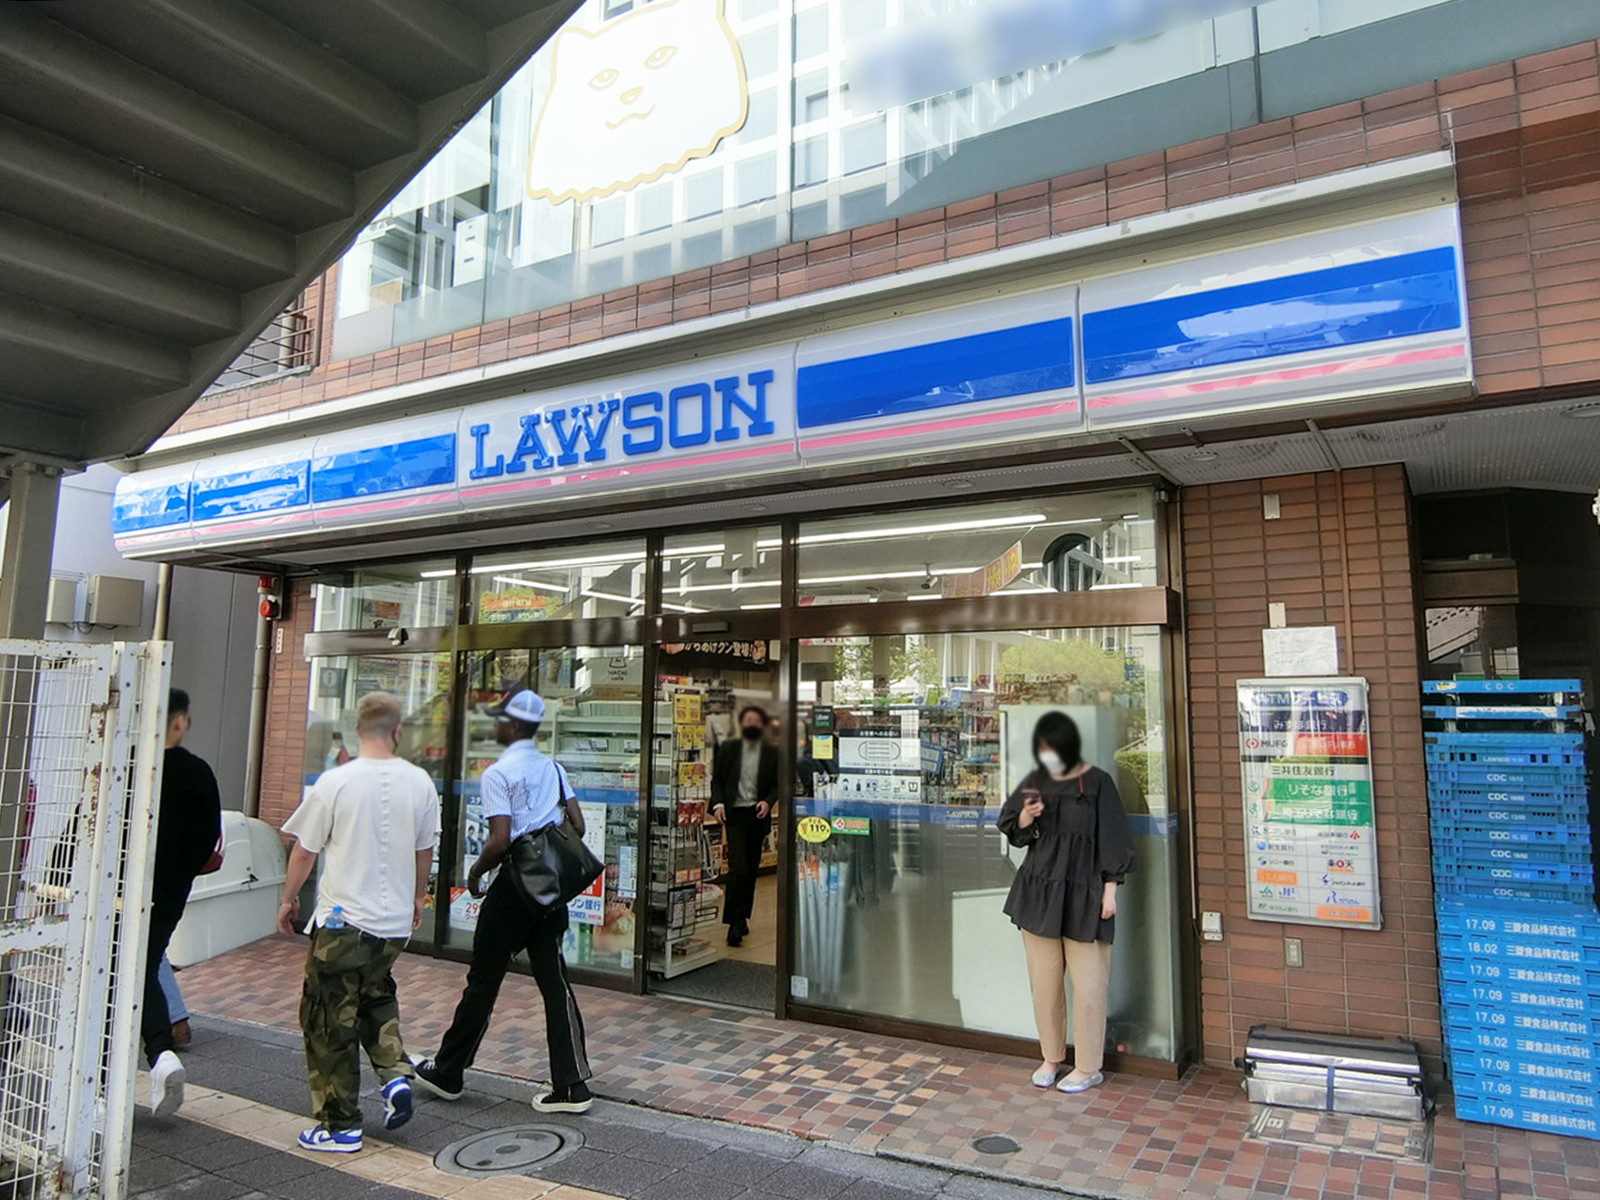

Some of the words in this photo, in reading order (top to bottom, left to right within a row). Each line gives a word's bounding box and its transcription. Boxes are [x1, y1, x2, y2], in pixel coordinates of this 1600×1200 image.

[470, 369, 774, 479] LAWSON
[1261, 739, 1288, 748] MUFG
[1272, 765, 1335, 776] 三井住友銀行
[1486, 773, 1507, 782] CDC
[1288, 784, 1348, 797] りそな銀行
[1487, 792, 1508, 801] CDC
[1488, 812, 1509, 820] CDC
[1489, 831, 1510, 840] CDC
[1490, 849, 1511, 858] CDC
[1491, 869, 1512, 878] CDC
[1493, 888, 1514, 897] CDC
[465, 901, 483, 914] 29
[1465, 918, 1496, 931] 17.09
[1503, 921, 1577, 938] 三菱食品株式会社
[1468, 942, 1498, 955] 18.02
[1506, 945, 1580, 962] 三菱食品株式会社
[1470, 965, 1500, 978] 17.09
[1508, 968, 1582, 986] 三菱食品株式会社
[1472, 988, 1503, 1001] 17.09
[1511, 991, 1584, 1010] 三菱食品株式会社
[1475, 1011, 1506, 1025] 17.09
[1513, 1015, 1588, 1035] 三菱食品株式会社
[1477, 1034, 1508, 1048] 18.02
[1516, 1038, 1591, 1059] 三菱食品株式会社
[1479, 1057, 1510, 1072] 17.09
[1518, 1062, 1593, 1083] 三菱食品株式会社
[1481, 1081, 1512, 1095] 17.09
[1520, 1086, 1594, 1107] 三菱食品株式会社
[1483, 1104, 1514, 1119] 17.09
[1522, 1110, 1596, 1131] 三菱食品株式会社
